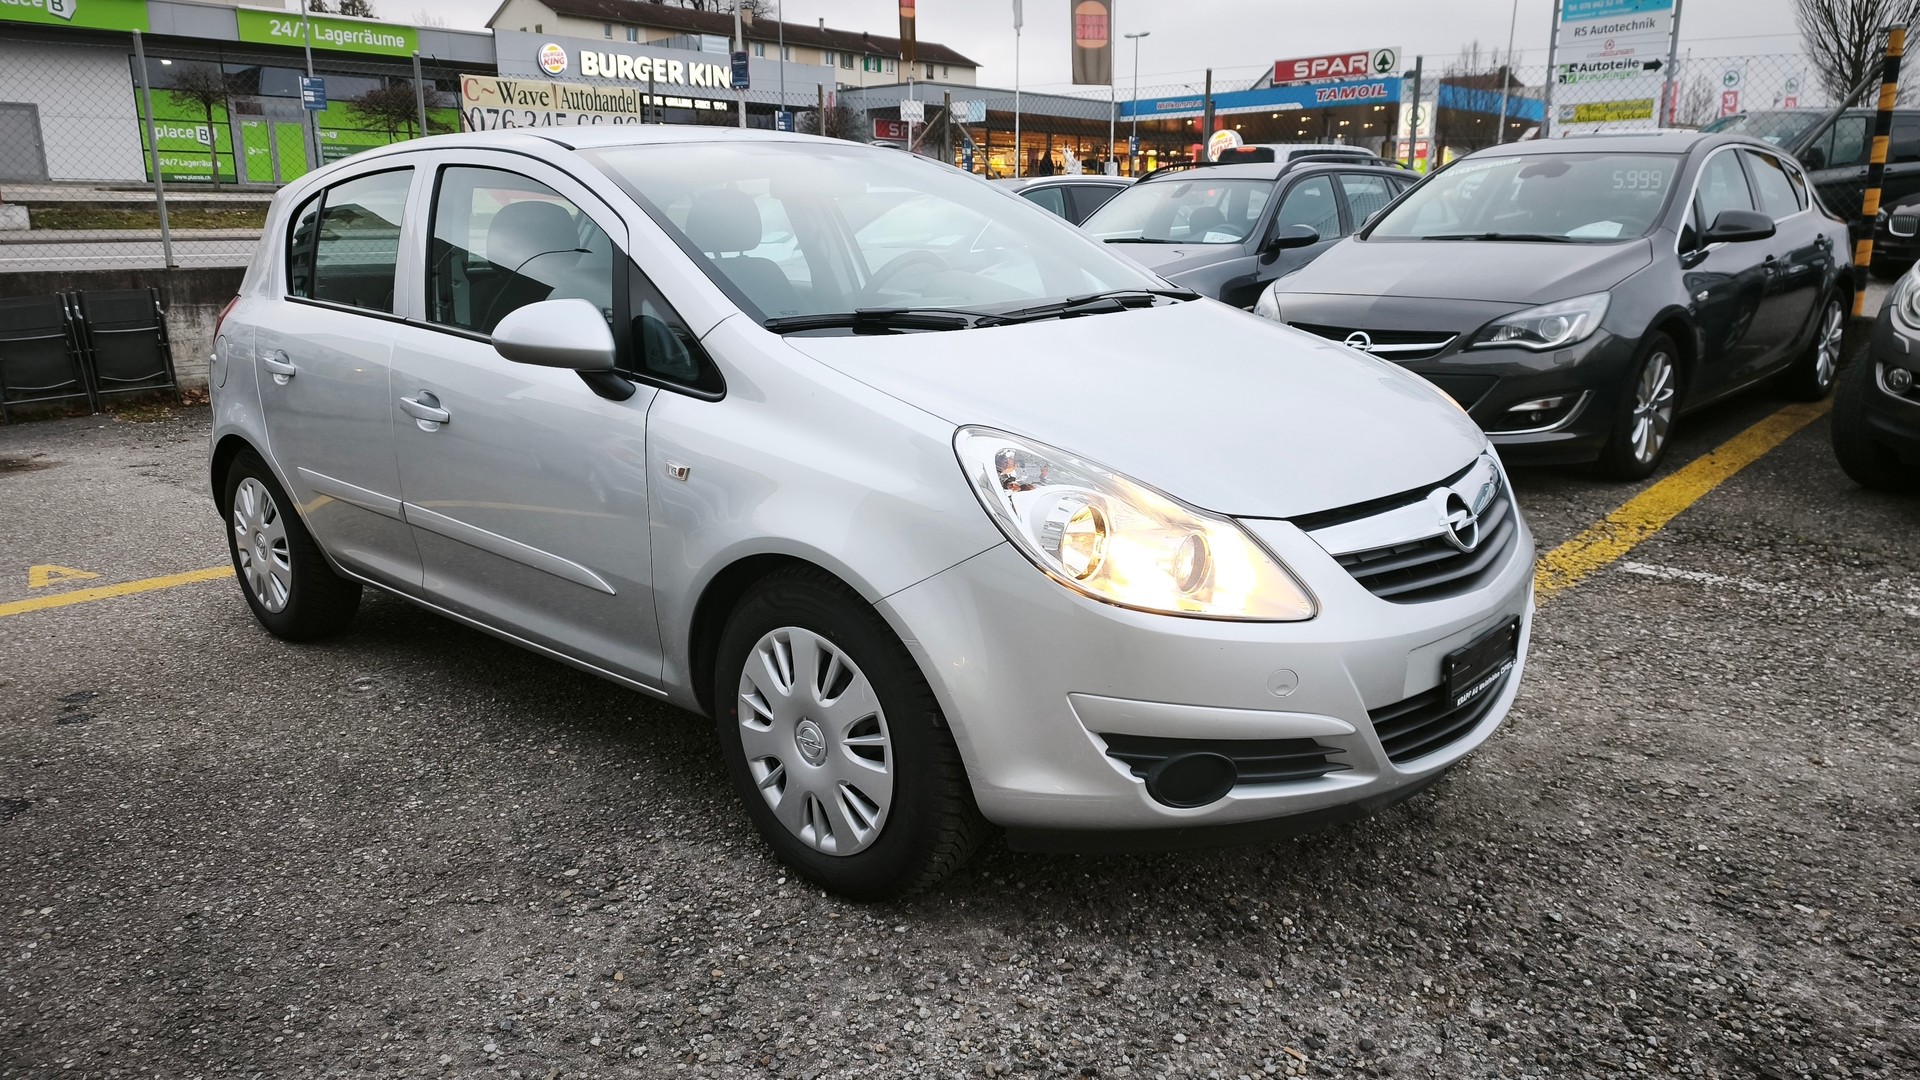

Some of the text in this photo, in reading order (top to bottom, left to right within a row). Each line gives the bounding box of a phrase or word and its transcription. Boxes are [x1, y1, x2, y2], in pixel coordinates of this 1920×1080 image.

[1574, 17, 1657, 37] RS Autotechnik
[314, 24, 405, 48] Lagerräume
[543, 57, 565, 66] KING
[579, 50, 733, 89] BURGER KIN
[1293, 54, 1368, 78] SPAR
[1579, 58, 1640, 73] Autoteile
[561, 86, 638, 113] Autohandel
[1315, 83, 1388, 102] TAMOIL
[713, 101, 728, 111] 1954
[1156, 100, 1203, 111] Willkommen
[155, 125, 195, 140] place
[179, 159, 222, 168] Lagerräue
[1456, 690, 1472, 706] KRAPF
